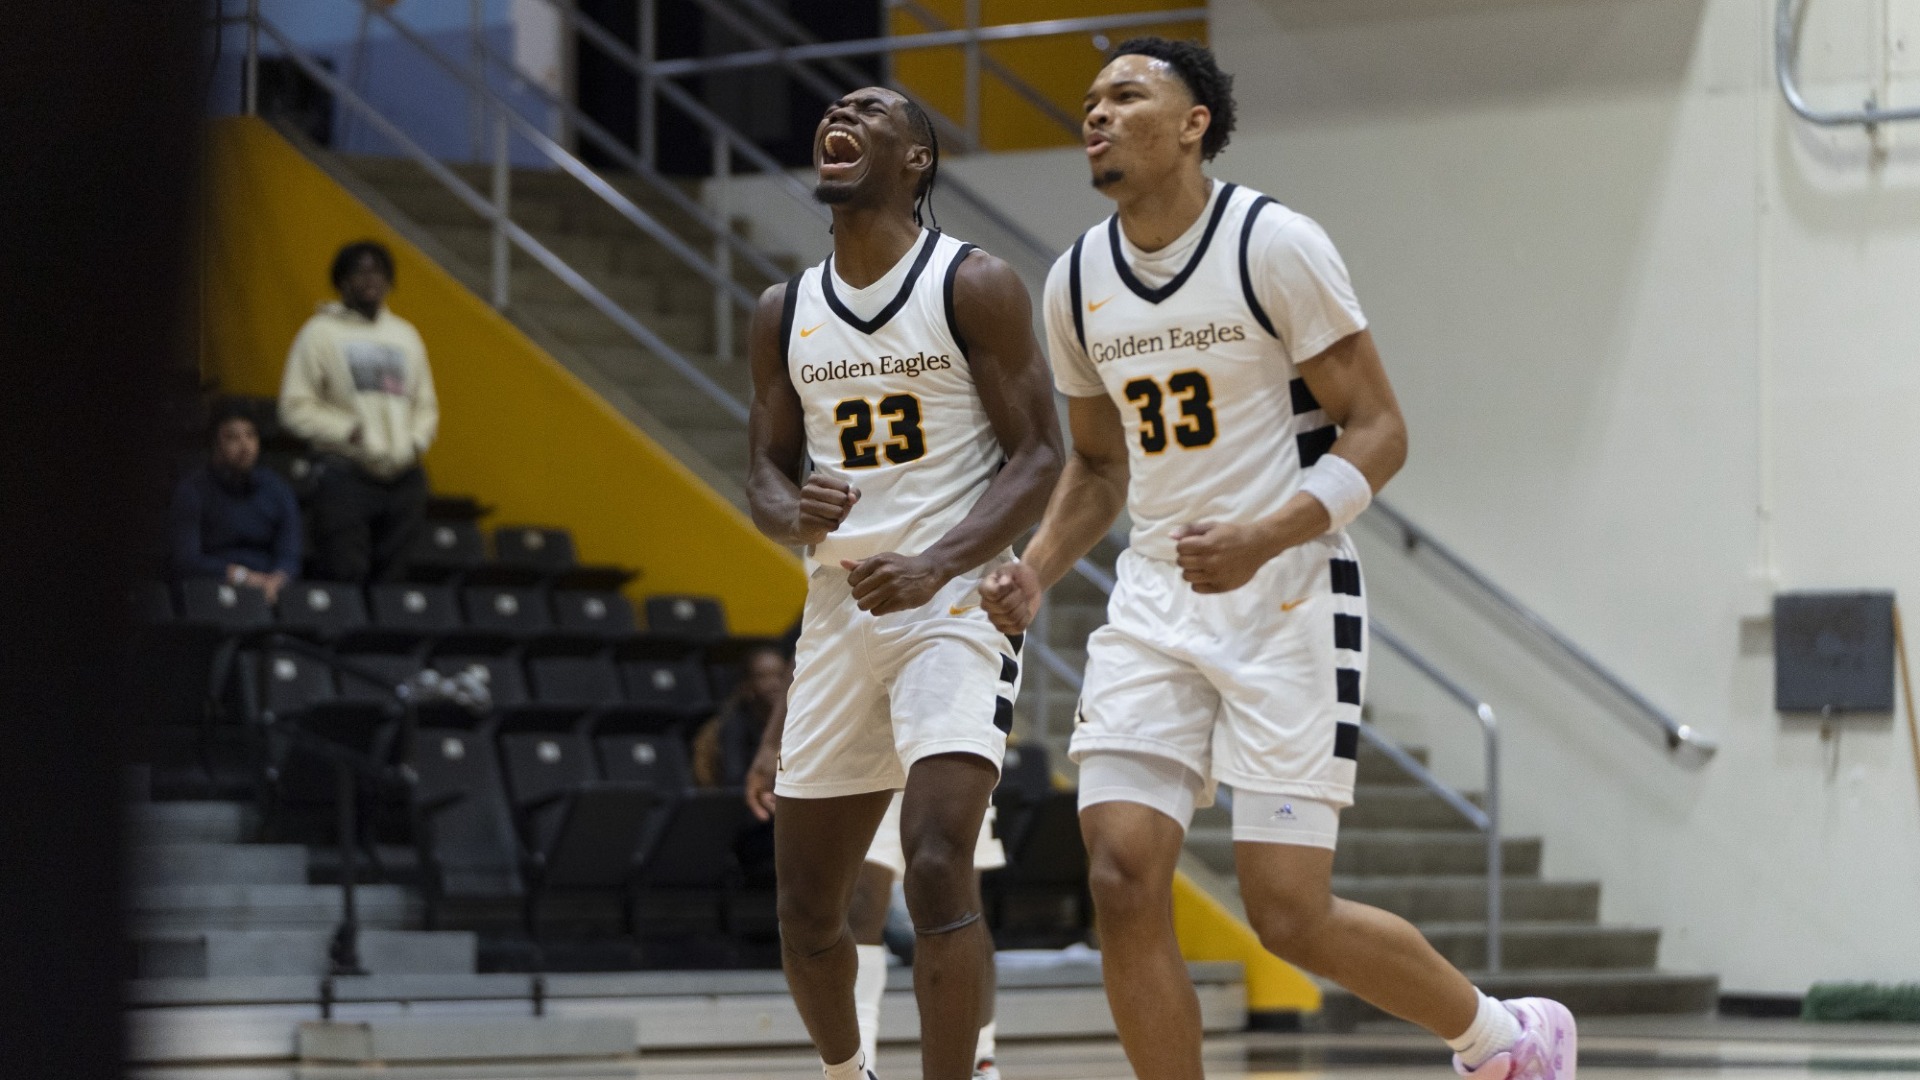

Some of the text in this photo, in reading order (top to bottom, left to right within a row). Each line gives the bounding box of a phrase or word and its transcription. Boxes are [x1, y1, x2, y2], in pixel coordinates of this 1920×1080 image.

[801, 352, 952, 384] Golden Eagles
[1092, 323, 1245, 363] Golden Eagles
[833, 390, 928, 470] 23
[1122, 367, 1219, 456] 33
